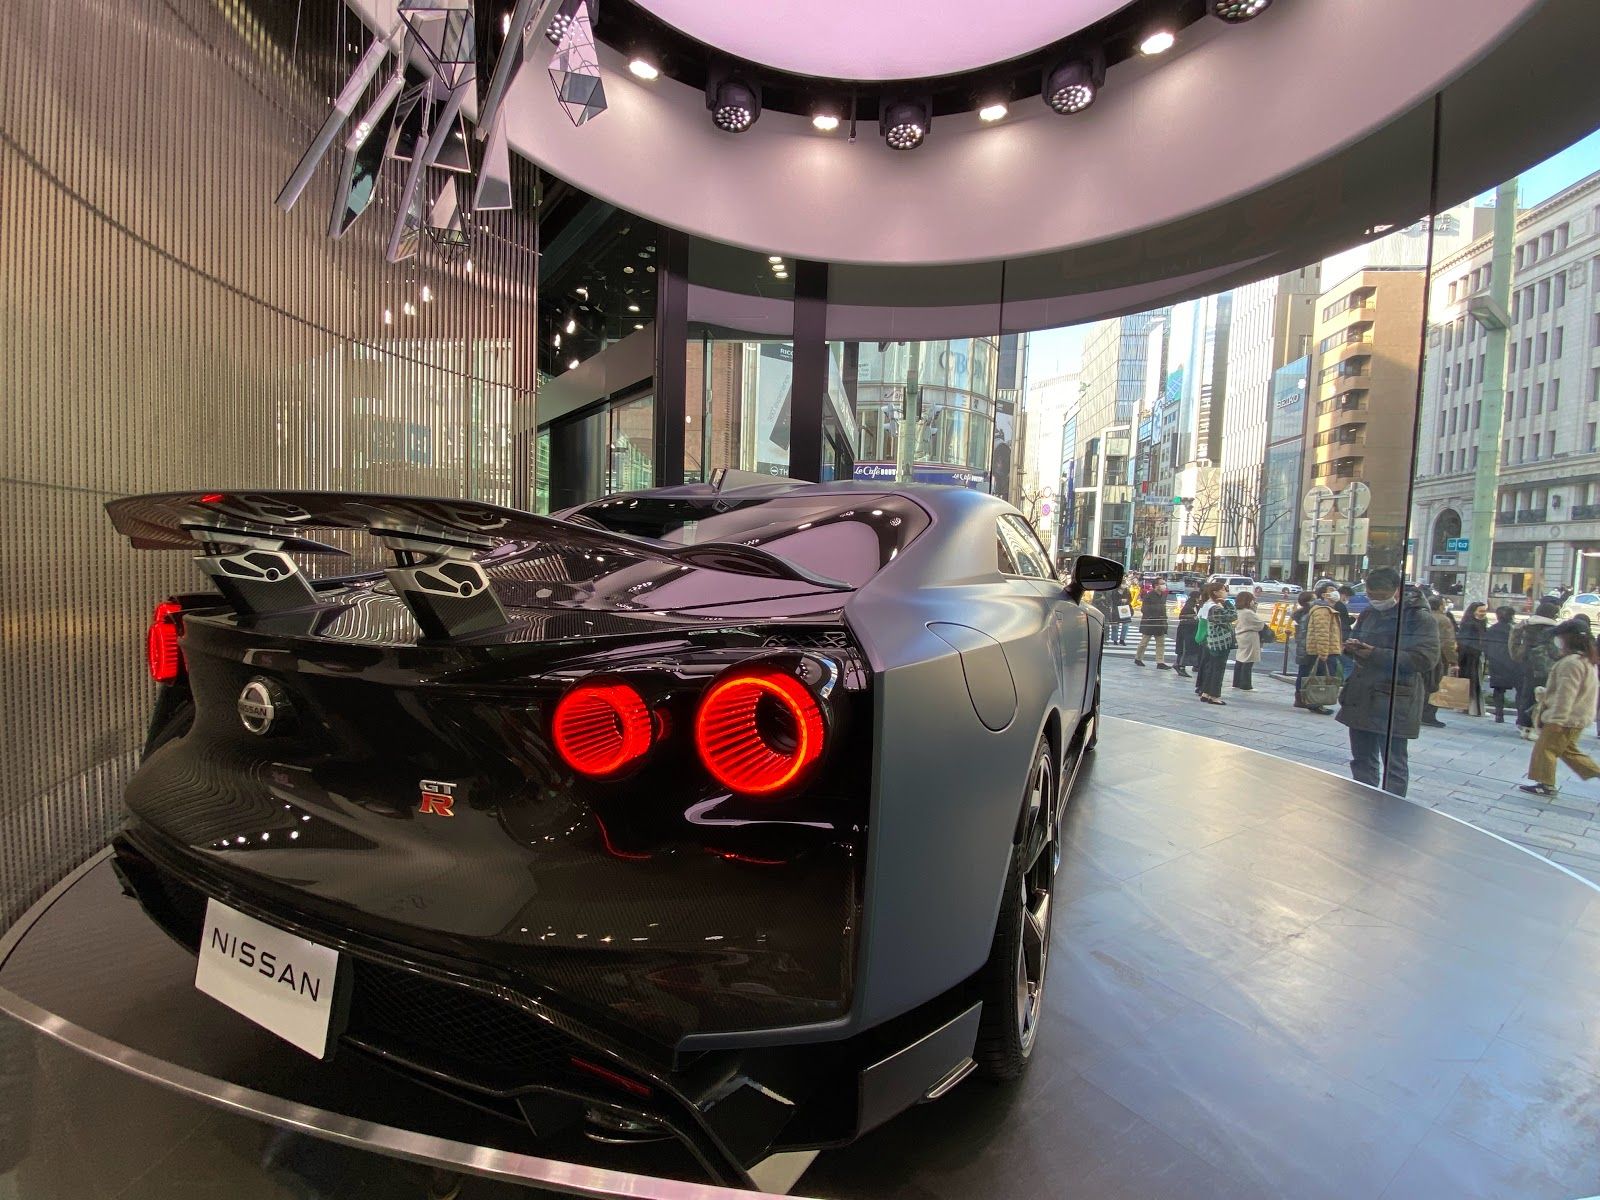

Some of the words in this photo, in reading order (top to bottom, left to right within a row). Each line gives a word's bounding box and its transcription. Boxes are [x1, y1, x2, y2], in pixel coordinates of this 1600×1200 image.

[1276, 393, 1299, 409] SEIKO
[419, 779, 457, 794] GT
[418, 792, 455, 816] R
[211, 927, 320, 1002] NISSAN
